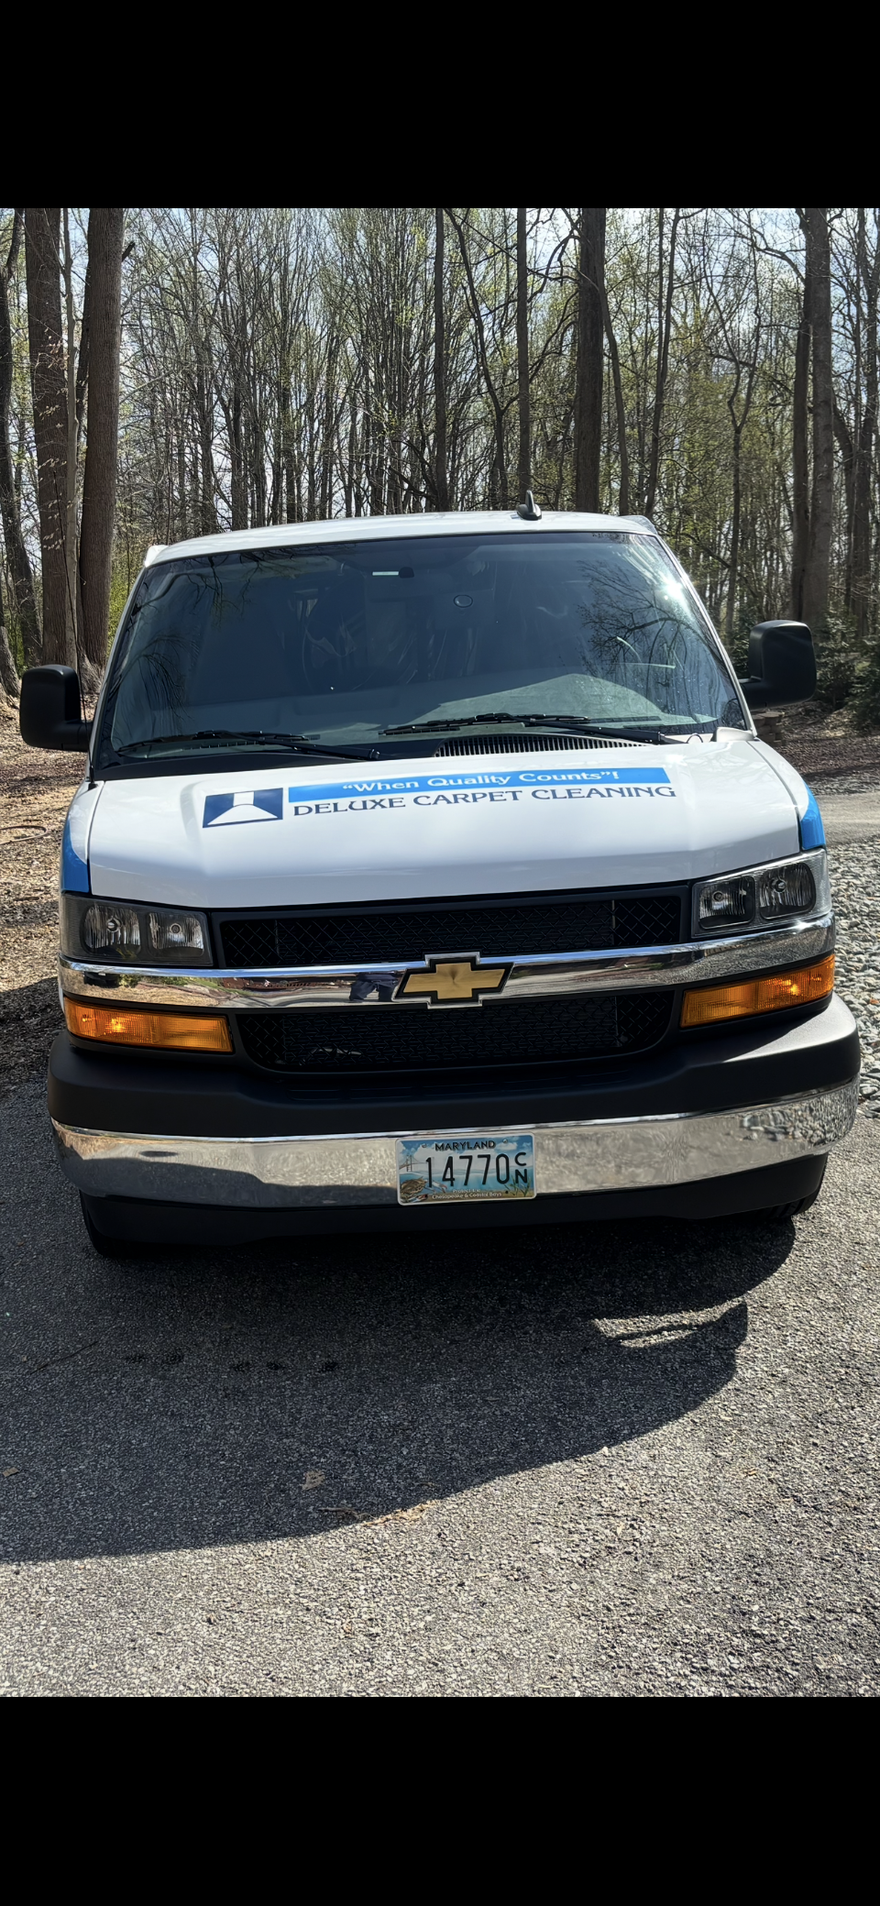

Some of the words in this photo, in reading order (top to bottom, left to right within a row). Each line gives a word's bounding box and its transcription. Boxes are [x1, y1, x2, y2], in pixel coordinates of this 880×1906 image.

[427, 774, 512, 787] Quality
[294, 797, 406, 816] DELUXE
[413, 790, 523, 806] CARPET
[531, 786, 677, 800] CLEANING
[435, 1140, 496, 1151] MARYLAND
[426, 1153, 510, 1188] 14770
